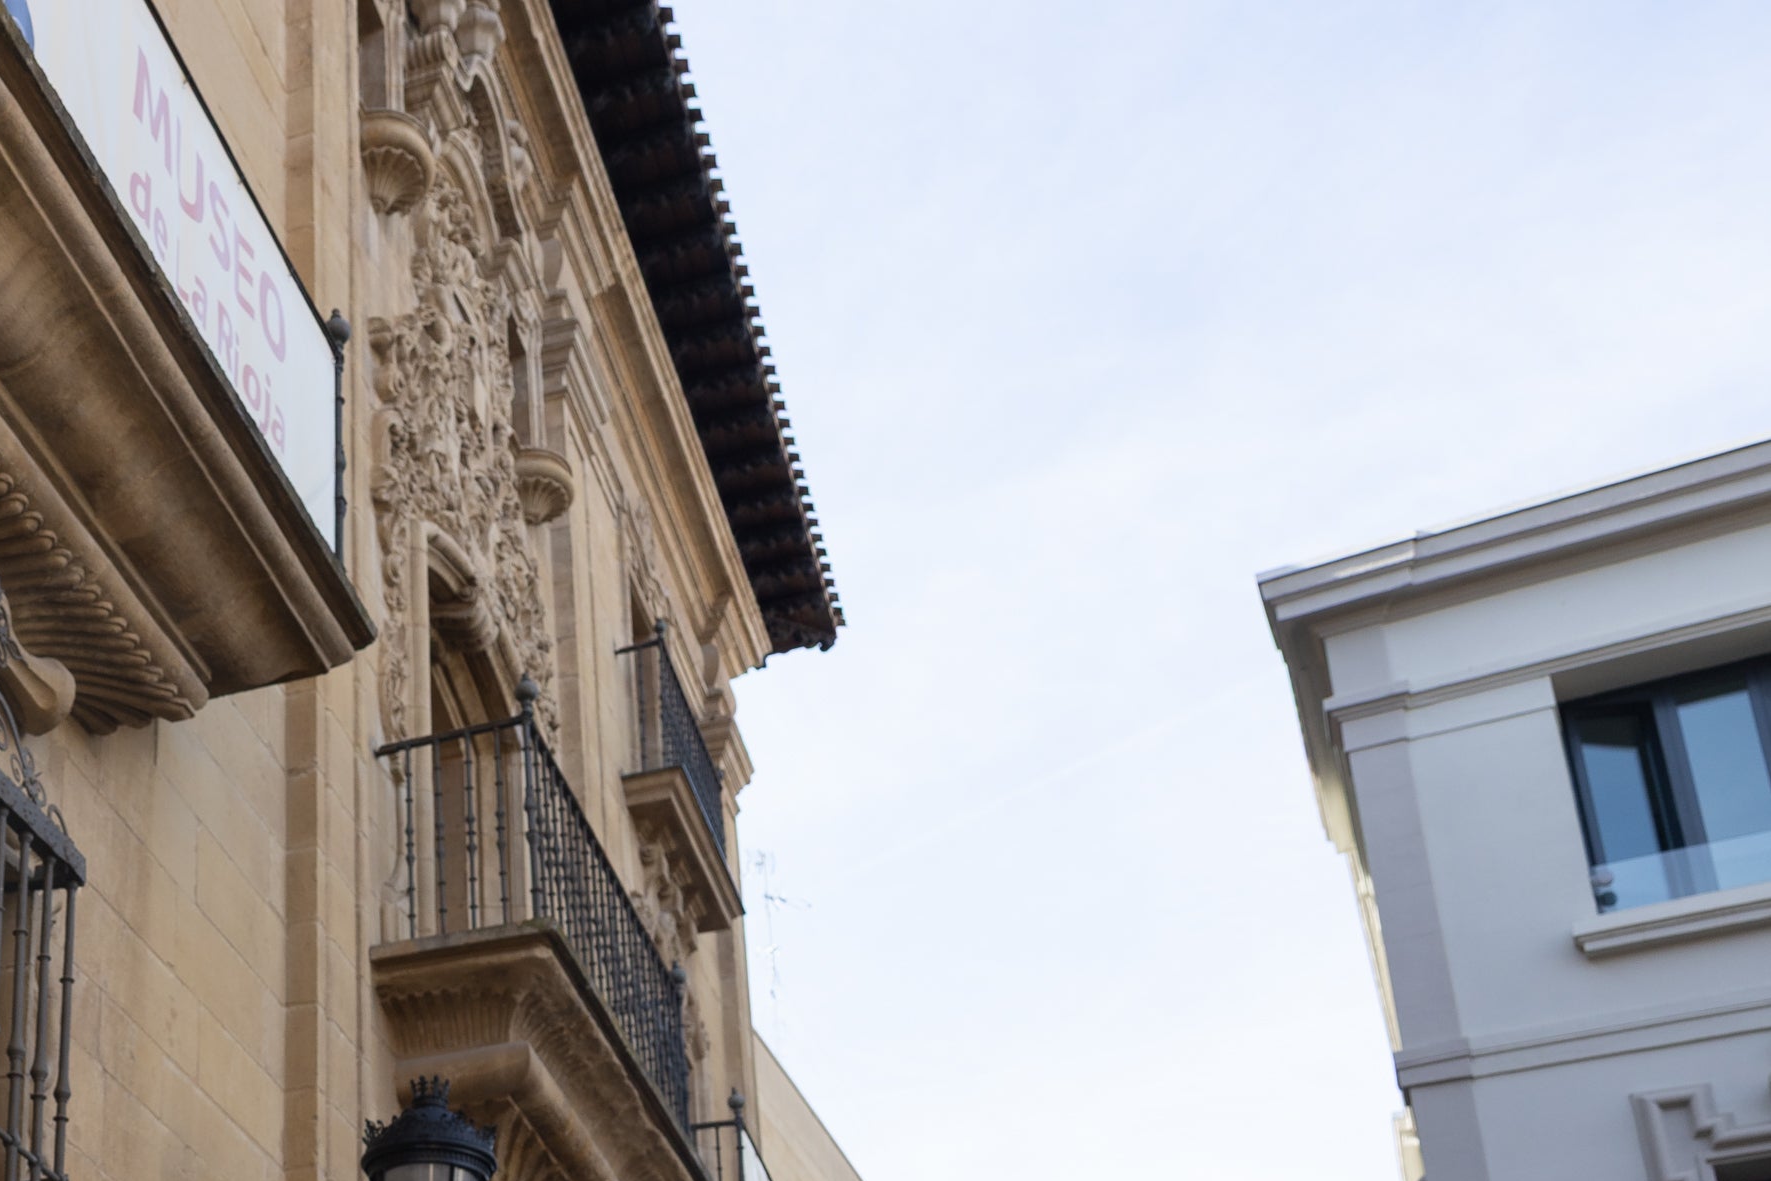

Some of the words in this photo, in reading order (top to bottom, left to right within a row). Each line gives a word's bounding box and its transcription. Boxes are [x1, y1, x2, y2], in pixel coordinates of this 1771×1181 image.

[129, 169, 169, 262] de
[176, 236, 208, 331] La
[217, 299, 286, 455] Rioja
[132, 45, 287, 363] MUSEO
